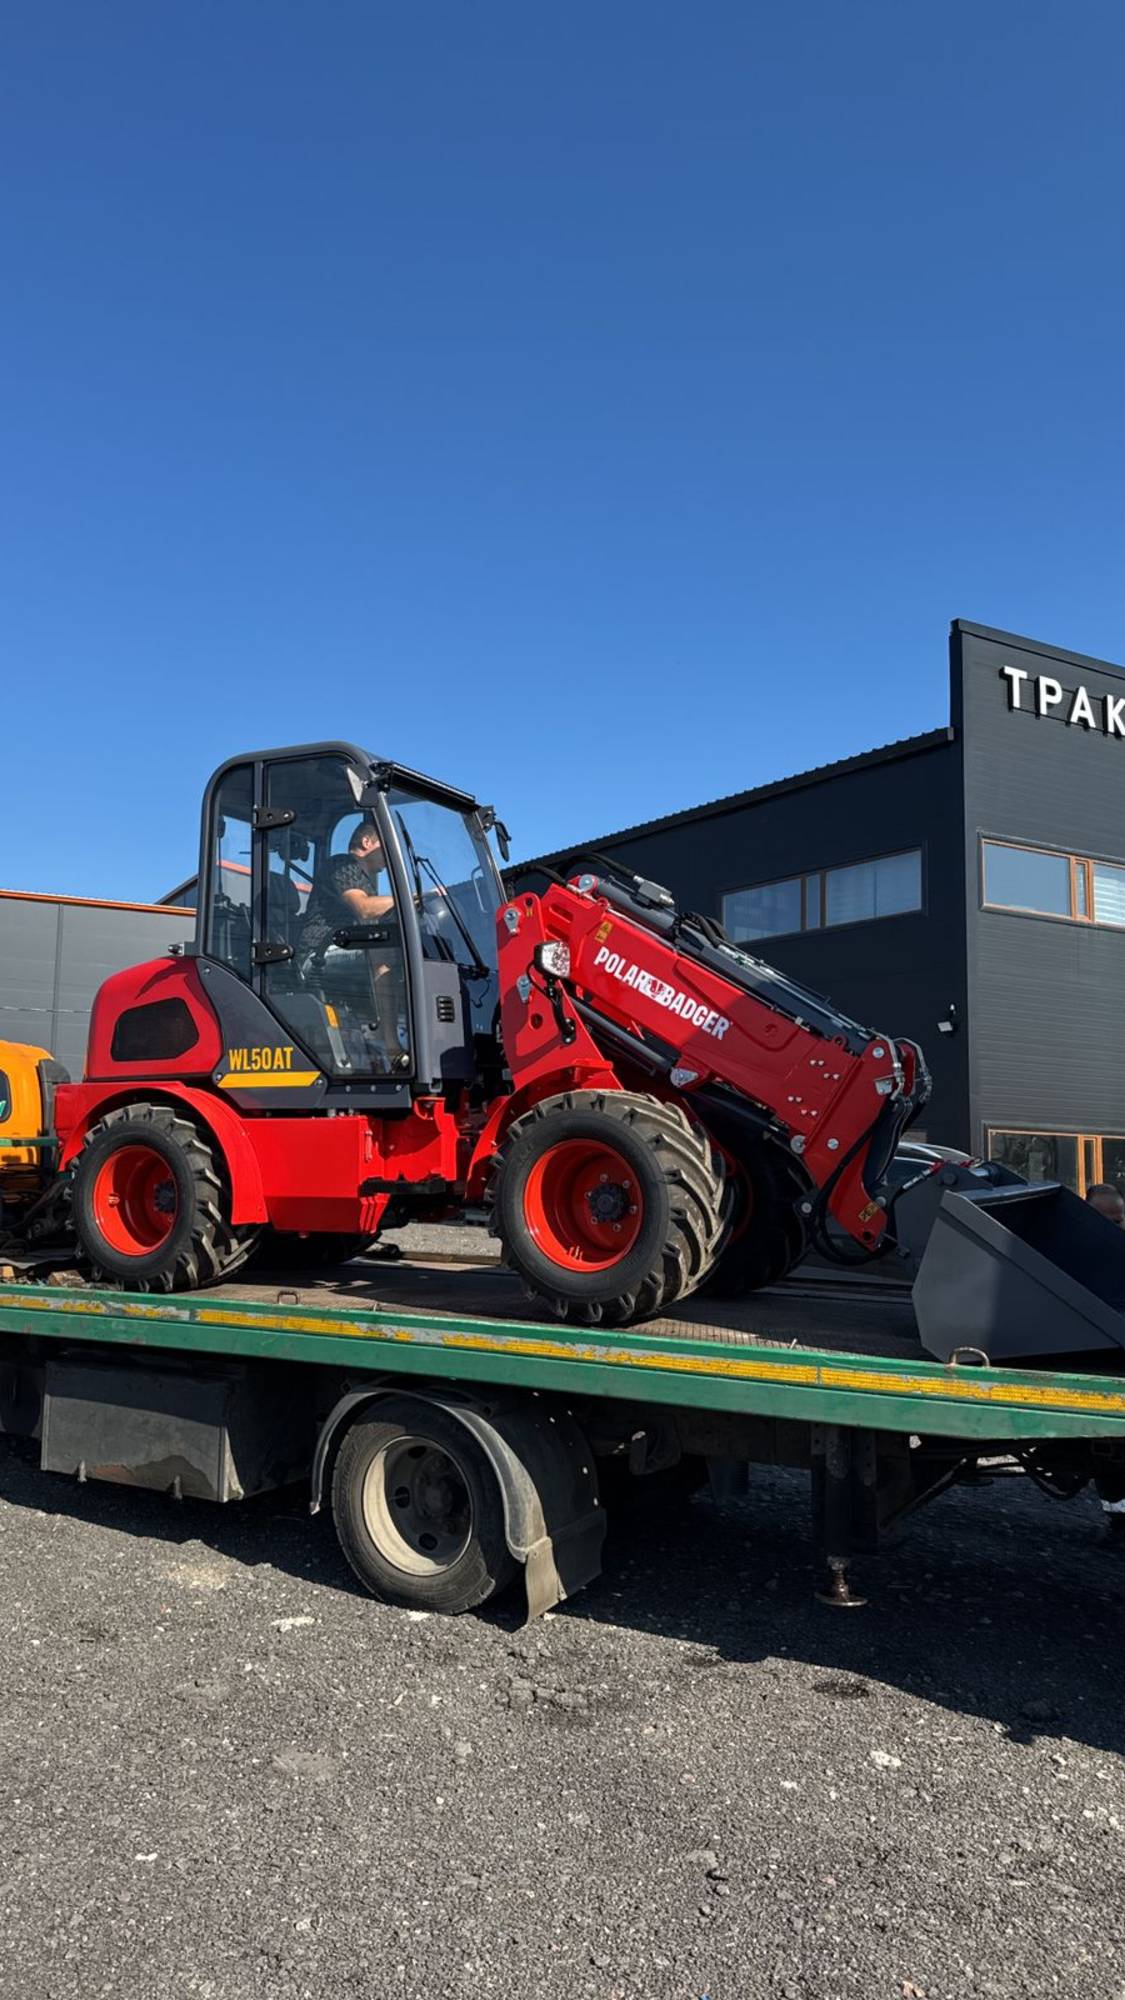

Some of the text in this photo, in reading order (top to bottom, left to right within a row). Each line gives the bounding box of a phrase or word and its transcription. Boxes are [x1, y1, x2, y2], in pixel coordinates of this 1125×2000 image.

[593, 945, 730, 1040] POLAR BADGER
[229, 1047, 293, 1070] WL50AT
